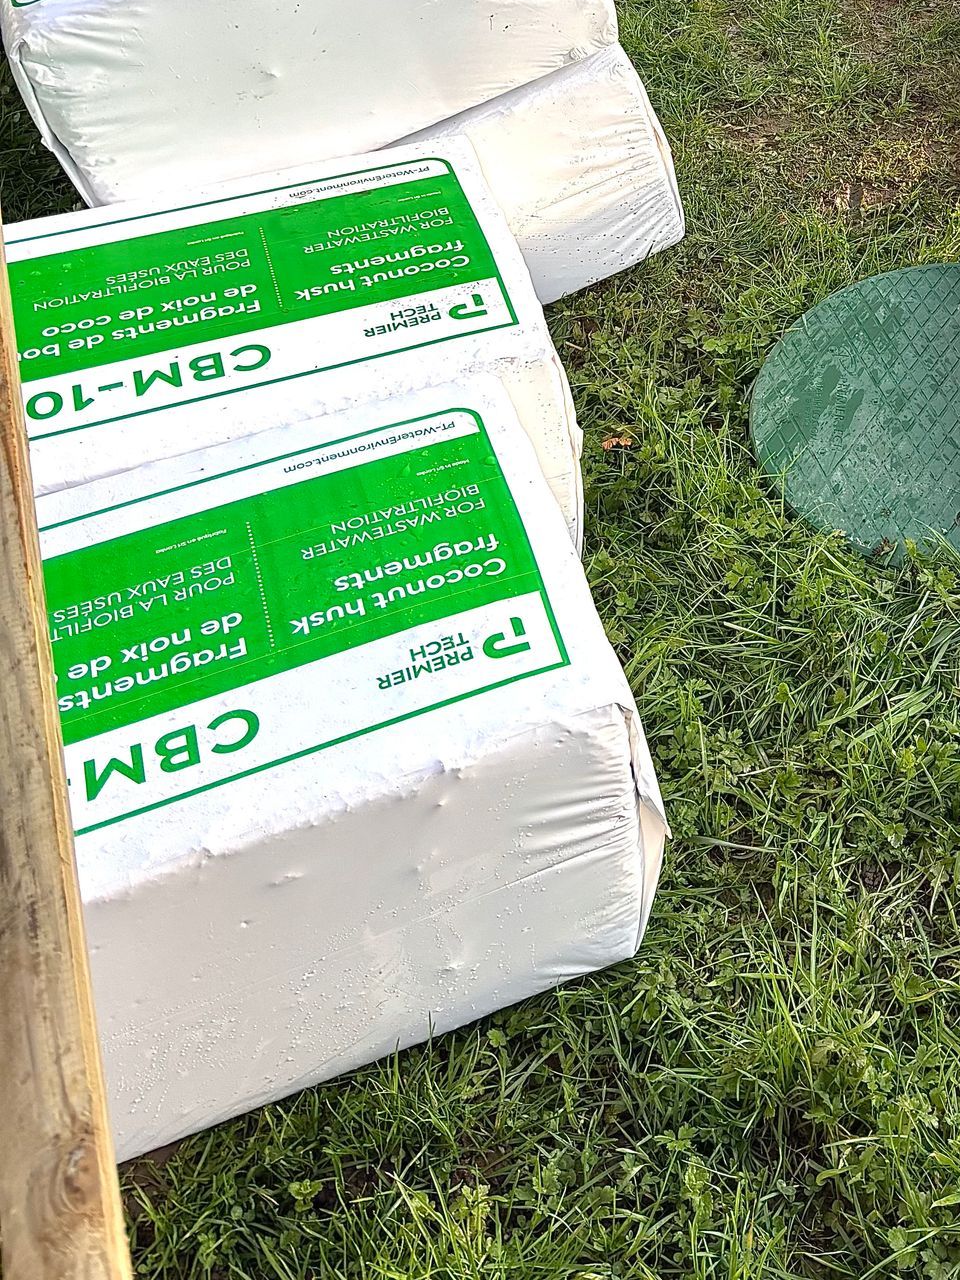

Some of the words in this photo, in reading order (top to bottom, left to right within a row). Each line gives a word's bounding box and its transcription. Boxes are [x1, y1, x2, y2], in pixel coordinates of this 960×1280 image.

[289, 165, 430, 198] PT-WaterEnvironment.com
[327, 207, 449, 239] BIOFILTRATION
[417, 216, 454, 228] FOR
[303, 224, 418, 254] WASTEWATER
[165, 255, 210, 273] EAUX
[201, 258, 252, 276] POUR
[215, 248, 248, 261] DES
[330, 239, 465, 276] fragments
[106, 266, 161, 285] USÉES
[175, 269, 197, 281] LA
[361, 255, 471, 287] Coconut
[33, 275, 171, 312] BIOFILTRATION
[161, 291, 216, 312] noix
[223, 283, 258, 298] de
[296, 279, 356, 301] husk
[41, 314, 112, 337] coco
[111, 299, 261, 341] Fragments
[118, 305, 154, 321] de
[363, 311, 442, 338] PREMIER
[390, 303, 439, 322] TECH
[68, 333, 105, 349] de
[283, 421, 456, 474] PT-WaterEnvironment.com
[331, 483, 480, 534] BIOFILTRATION
[446, 497, 486, 517] FOR
[302, 511, 441, 560] WASTEWATER
[190, 556, 232, 576] DES
[334, 533, 500, 592] fragments
[128, 570, 184, 599] EAUX
[174, 571, 235, 601] POUR
[373, 557, 507, 608] Coconut
[54, 592, 122, 623] USÉES
[140, 593, 167, 612] LA
[289, 598, 365, 635] husk
[200, 612, 243, 636] de
[122, 628, 192, 663] noix
[409, 632, 470, 661] TECH
[58, 637, 248, 712] Fragments
[68, 655, 112, 680] de
[376, 646, 475, 690] PREMIER
[66, 709, 260, 802] CBM
